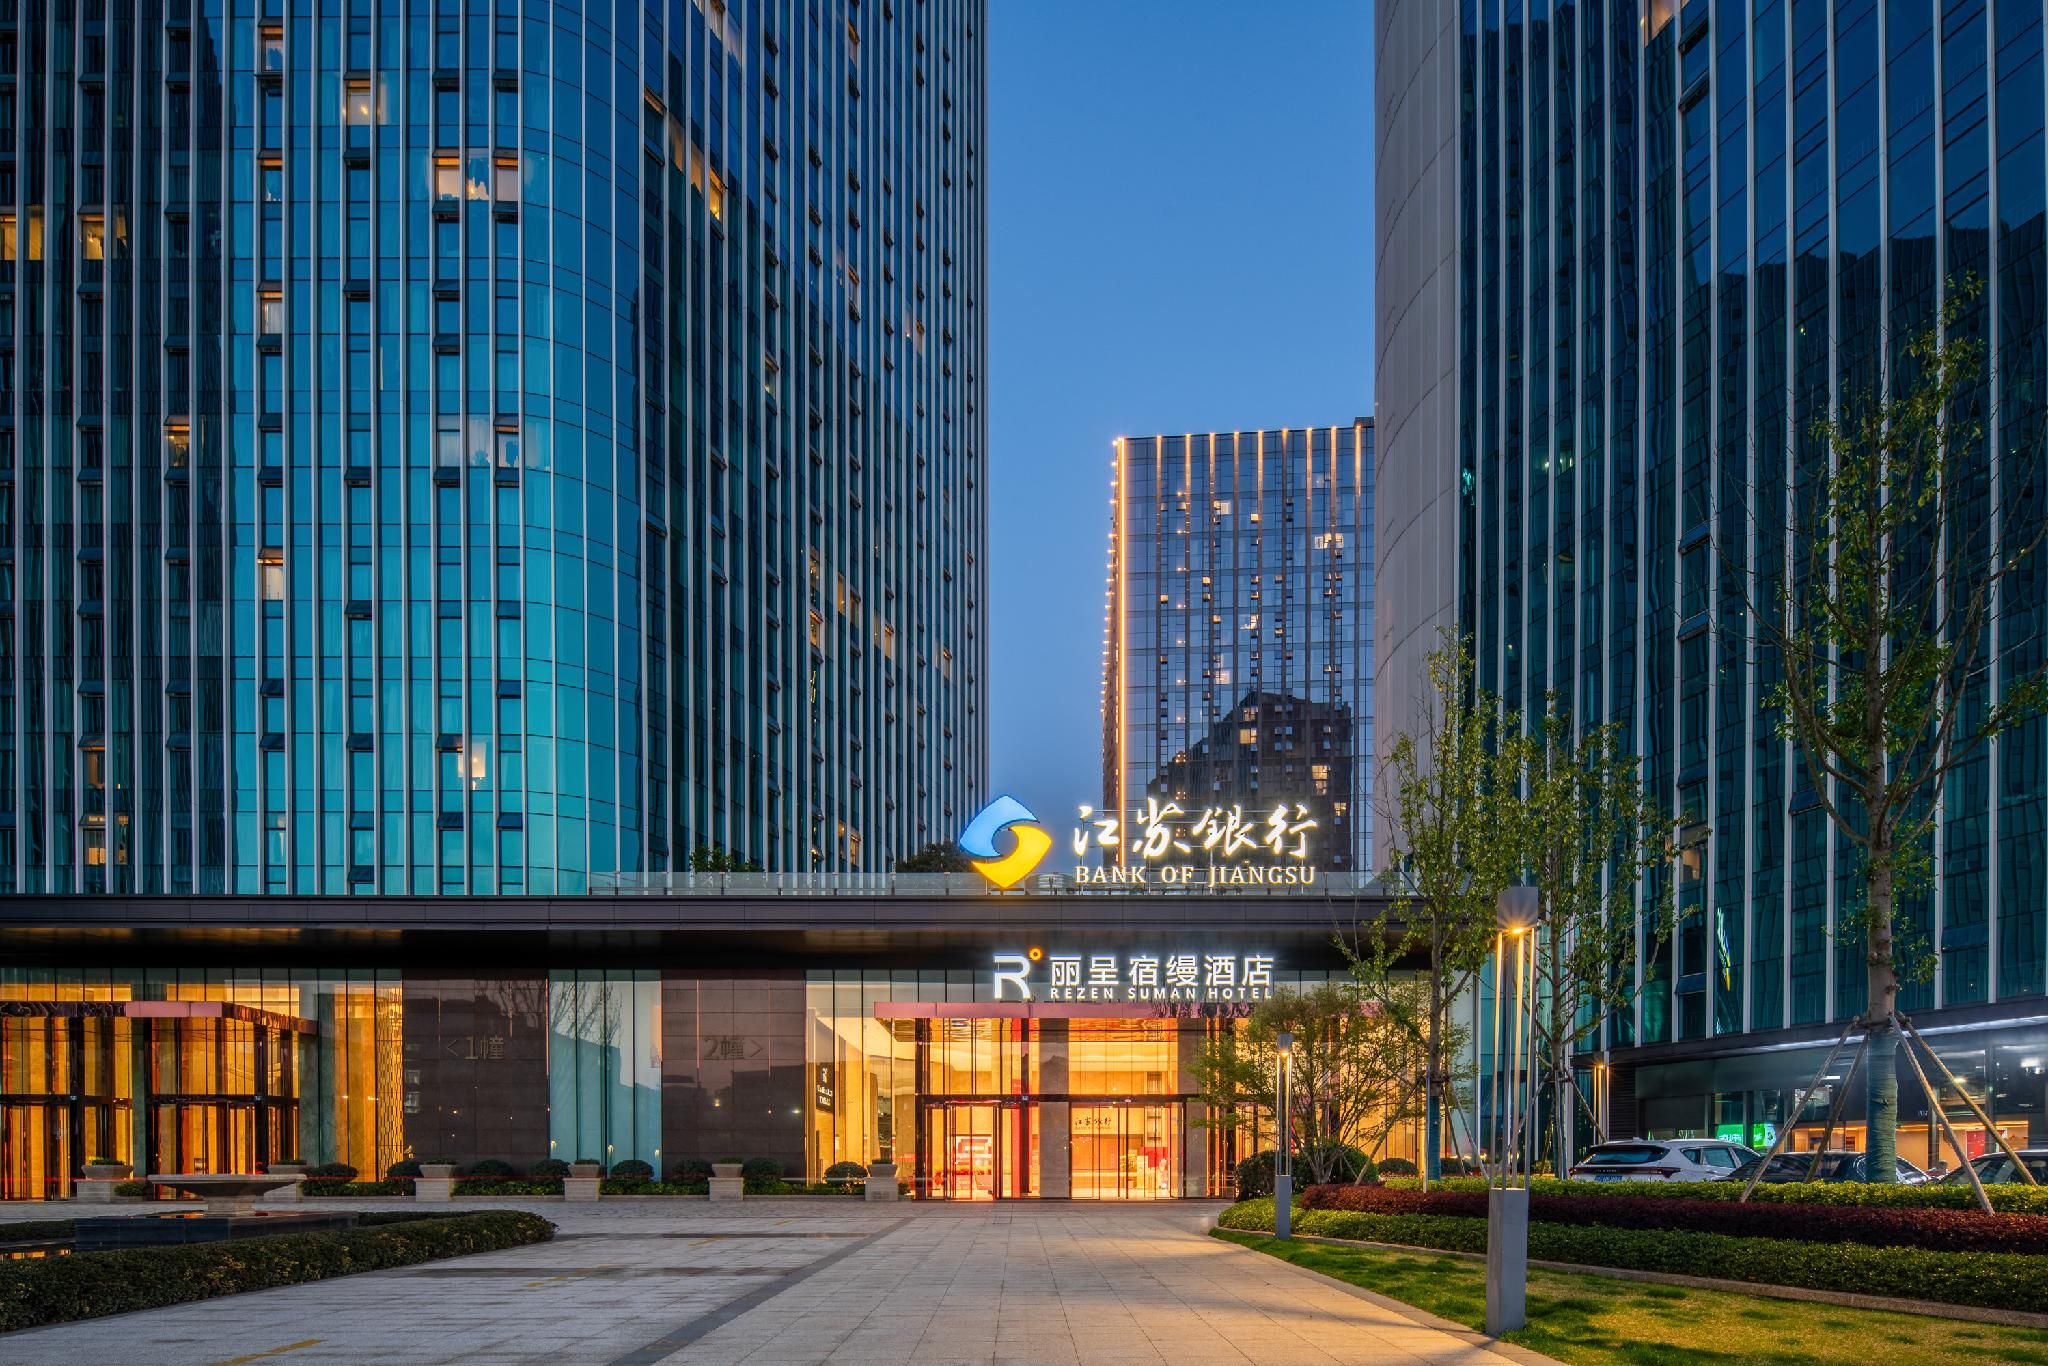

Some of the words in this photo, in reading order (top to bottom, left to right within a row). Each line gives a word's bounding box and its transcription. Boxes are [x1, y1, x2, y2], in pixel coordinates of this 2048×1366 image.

[1075, 866, 1147, 884] BANK
[1161, 866, 1195, 884] OF
[1209, 866, 1315, 888] JIANGSU
[1049, 954, 1274, 987] 丽呈宿缦酒店
[1050, 987, 1114, 1000] REZEN
[1127, 987, 1196, 1000] SUMAN
[1208, 987, 1272, 1000] HOTEL
